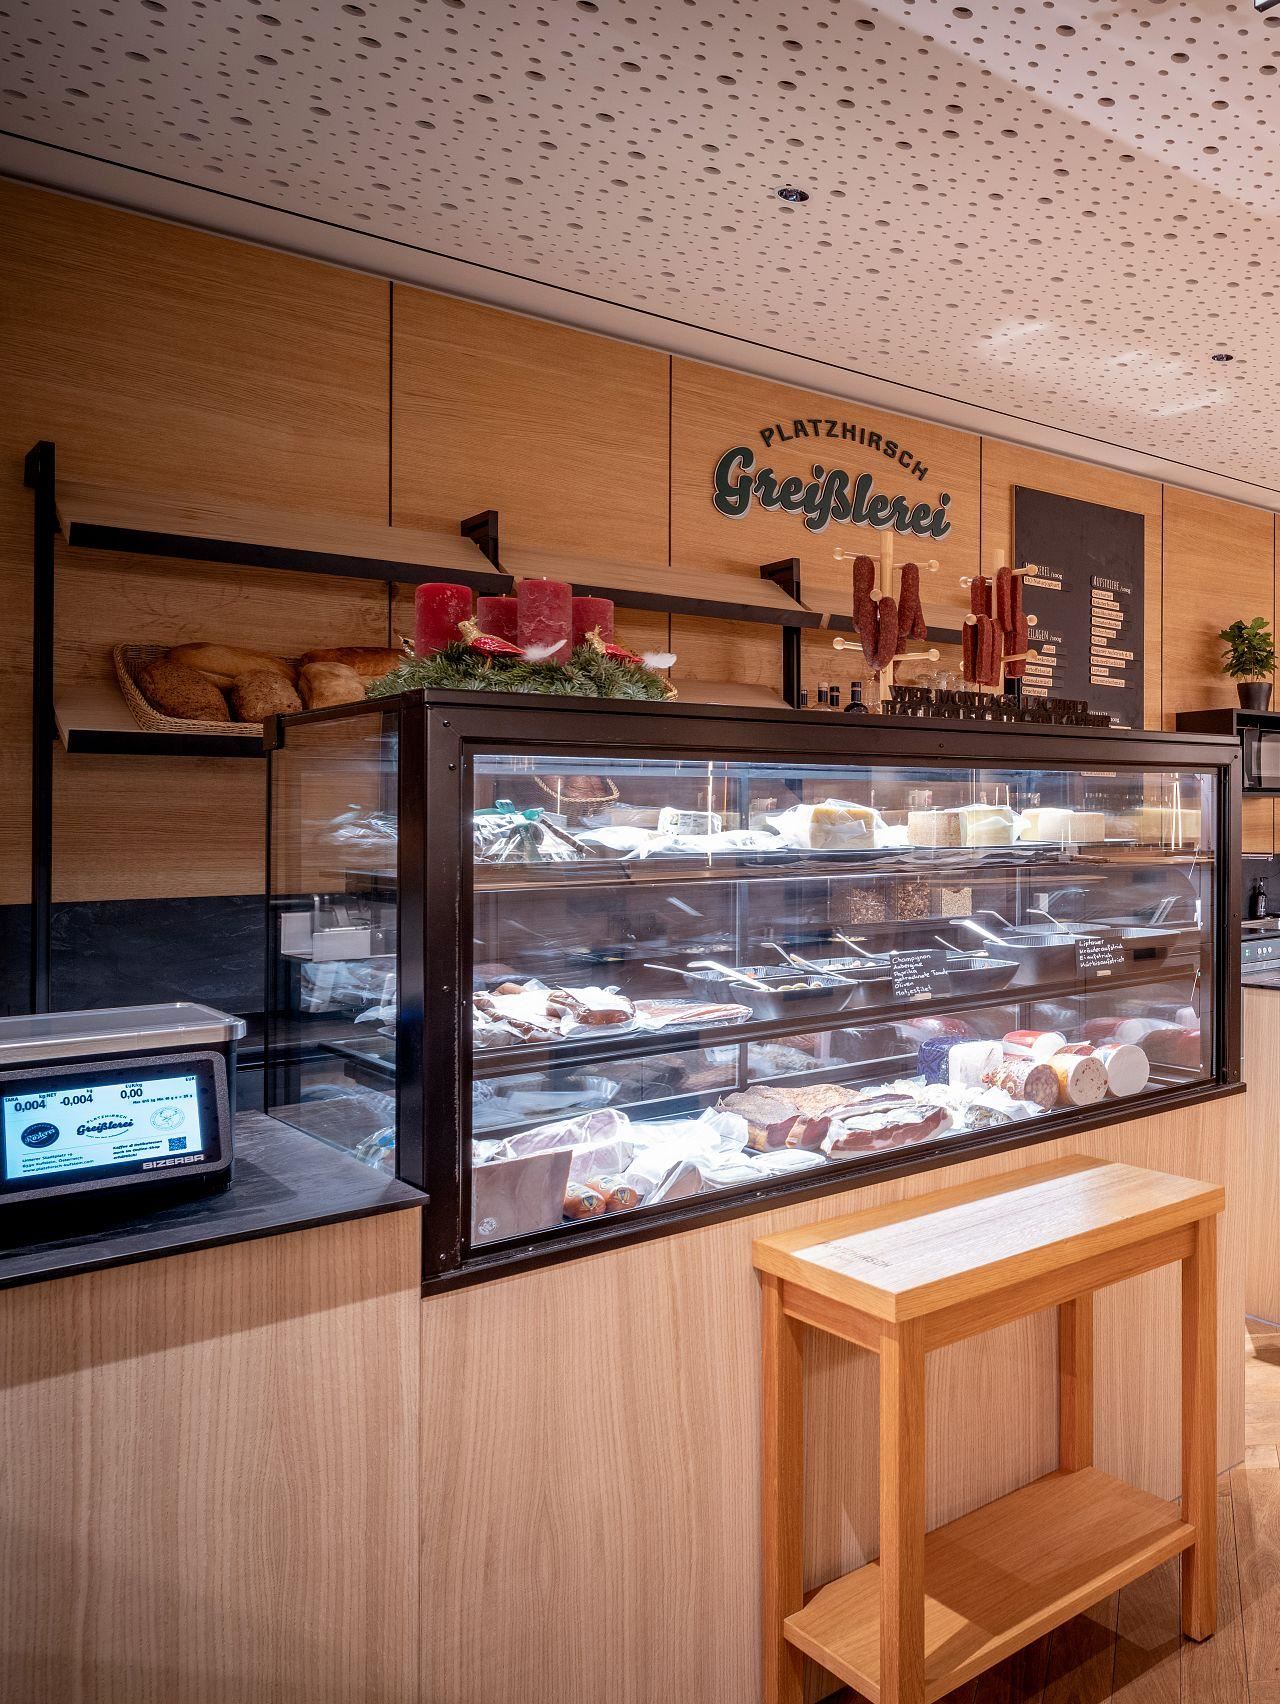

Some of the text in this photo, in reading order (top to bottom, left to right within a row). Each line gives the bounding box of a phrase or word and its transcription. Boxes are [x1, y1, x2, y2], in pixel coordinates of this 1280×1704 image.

[759, 418, 929, 481] PLATZHIRSCH
[712, 445, 952, 541] Greißlerei
[1028, 629, 1049, 640] EILAGEN
[1079, 939, 1105, 947] Liptauer
[892, 954, 932, 964] Champignon
[14, 1088, 143, 1113] 0,004 -0,004 0,00
[76, 1119, 134, 1136] Greißlerei
[143, 1154, 206, 1171] BIZERBA
